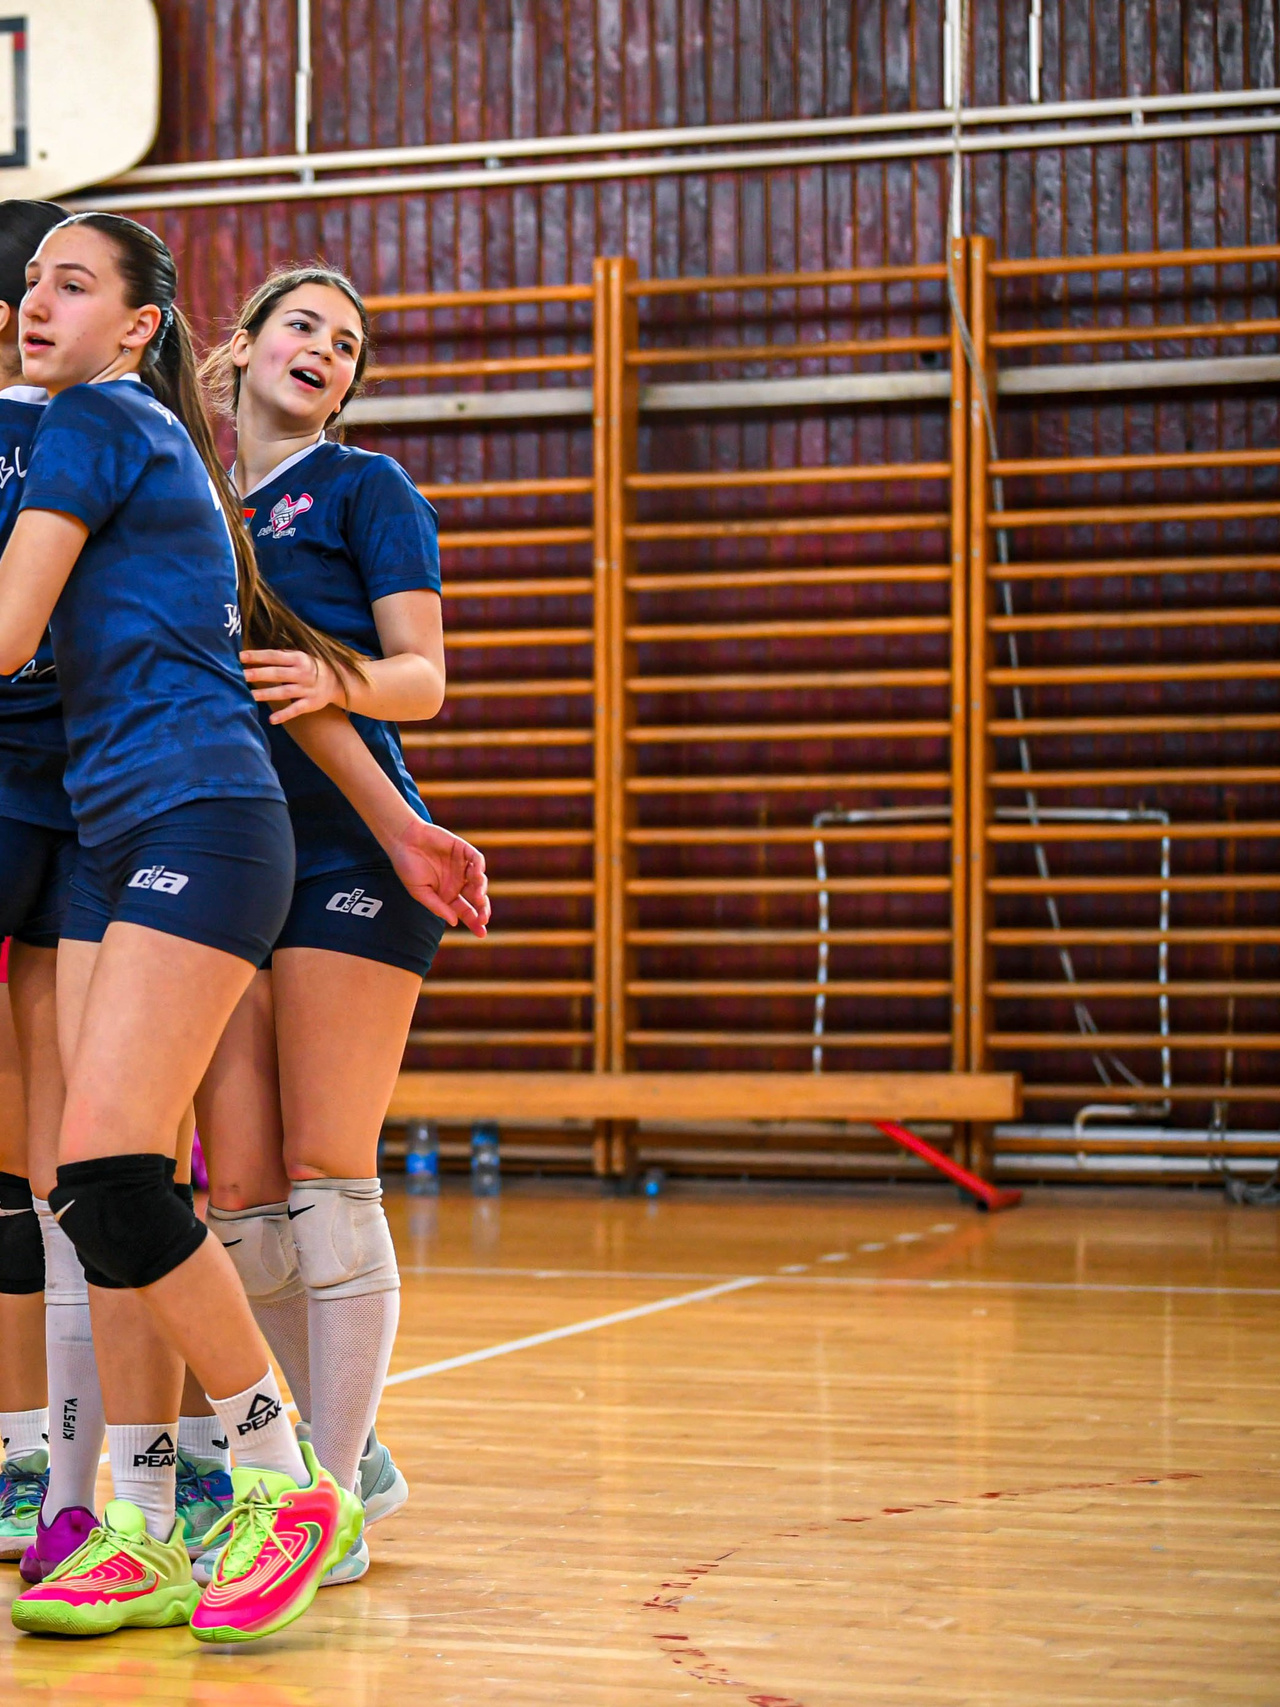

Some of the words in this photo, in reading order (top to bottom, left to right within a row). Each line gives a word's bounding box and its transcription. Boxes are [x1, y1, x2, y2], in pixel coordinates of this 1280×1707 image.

[62, 1397, 78, 1441] KIPSTA
[236, 1400, 283, 1436] PEAK
[133, 1454, 176, 1468] PEAK
